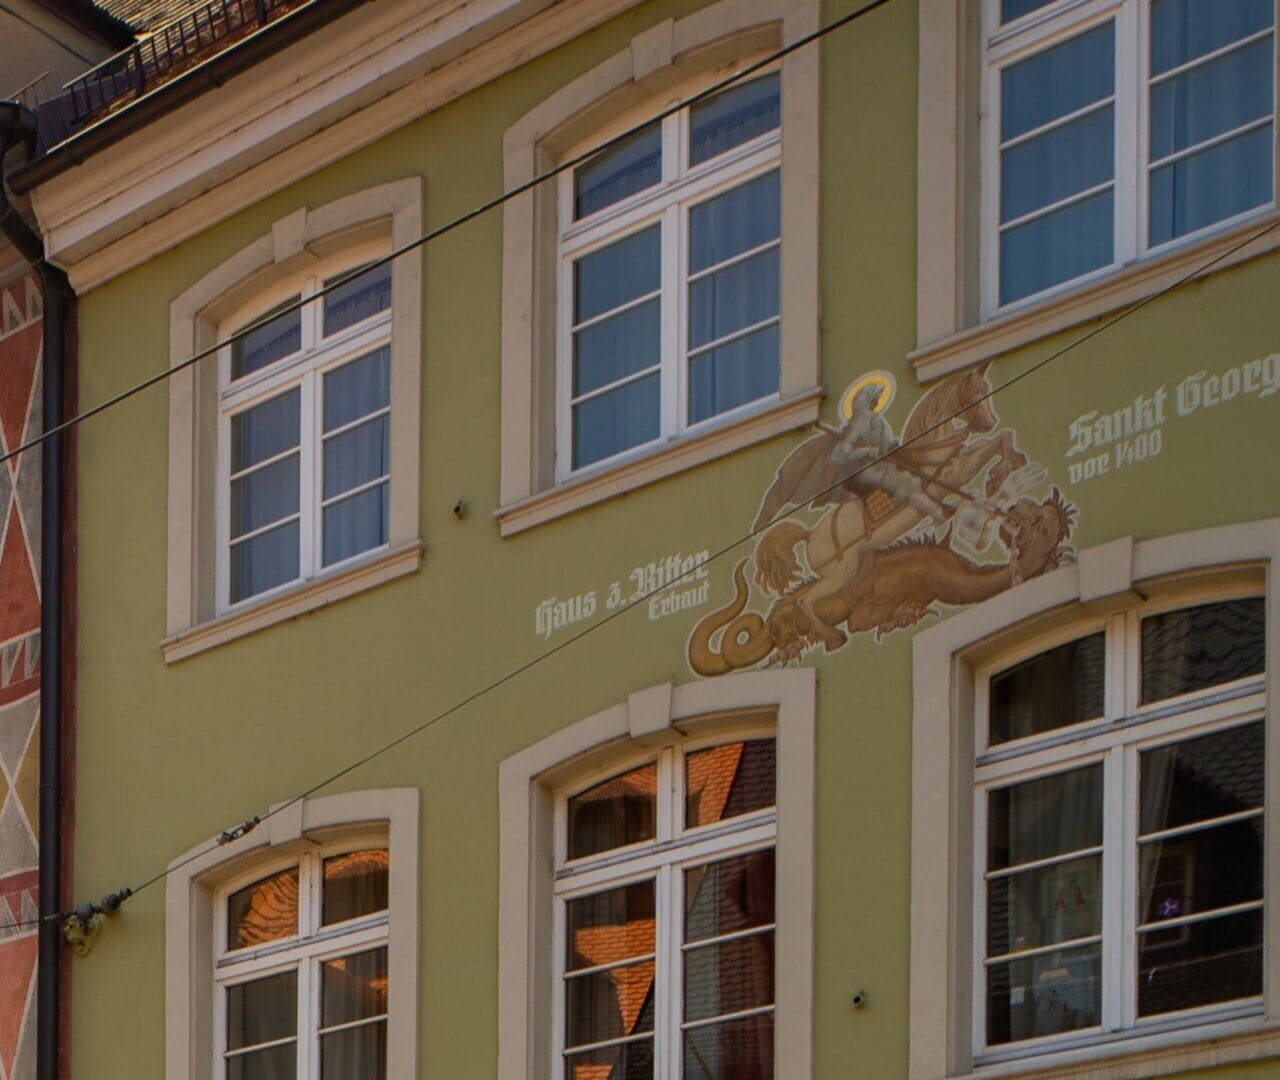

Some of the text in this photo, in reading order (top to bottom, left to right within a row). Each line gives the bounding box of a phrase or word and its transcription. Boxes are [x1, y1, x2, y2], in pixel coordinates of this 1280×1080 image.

[1065, 352, 1280, 457] Sankt Georg
[1115, 429, 1163, 469] 1400
[534, 591, 597, 639] Haus
[647, 579, 711, 620] Erbaut
